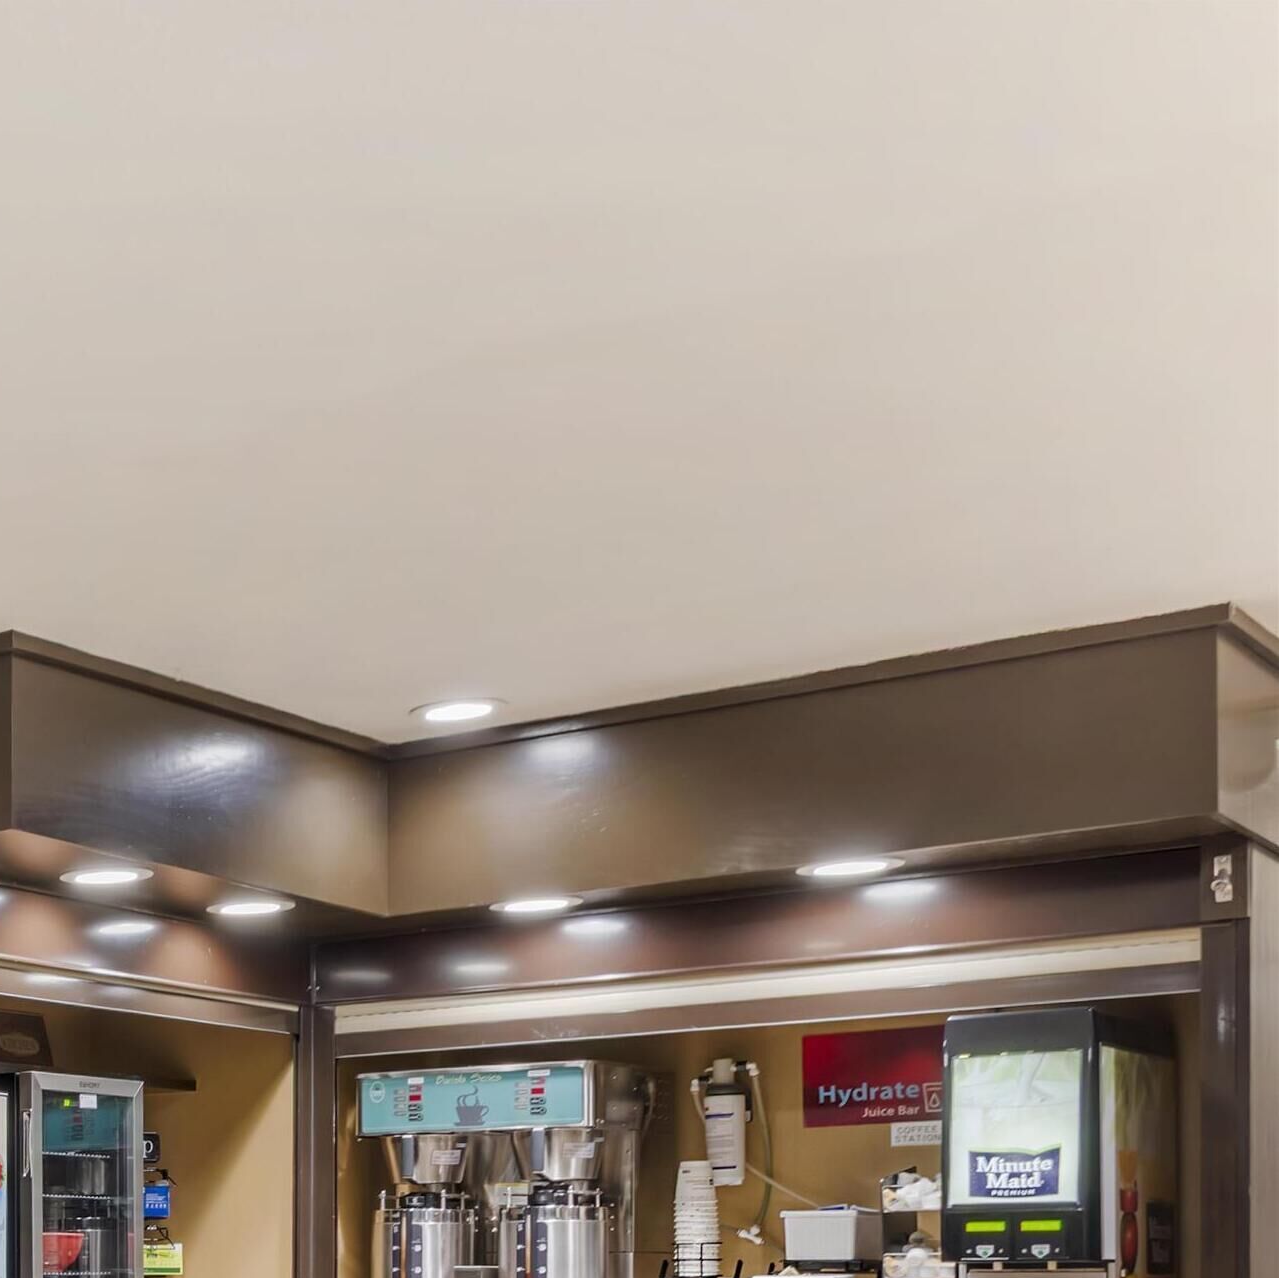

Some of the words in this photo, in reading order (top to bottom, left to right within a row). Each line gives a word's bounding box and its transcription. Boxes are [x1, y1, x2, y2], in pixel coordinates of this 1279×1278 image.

[818, 1082, 920, 1108] Hydrate
[862, 1107, 895, 1118] Juice
[897, 1105, 920, 1117] Bar
[897, 1125, 938, 1135] COFFEE
[894, 1134, 942, 1143] STATION
[975, 1156, 1054, 1173] Minute
[985, 1171, 1042, 1189] Maid
[990, 1188, 1036, 1197] PREMIUM
